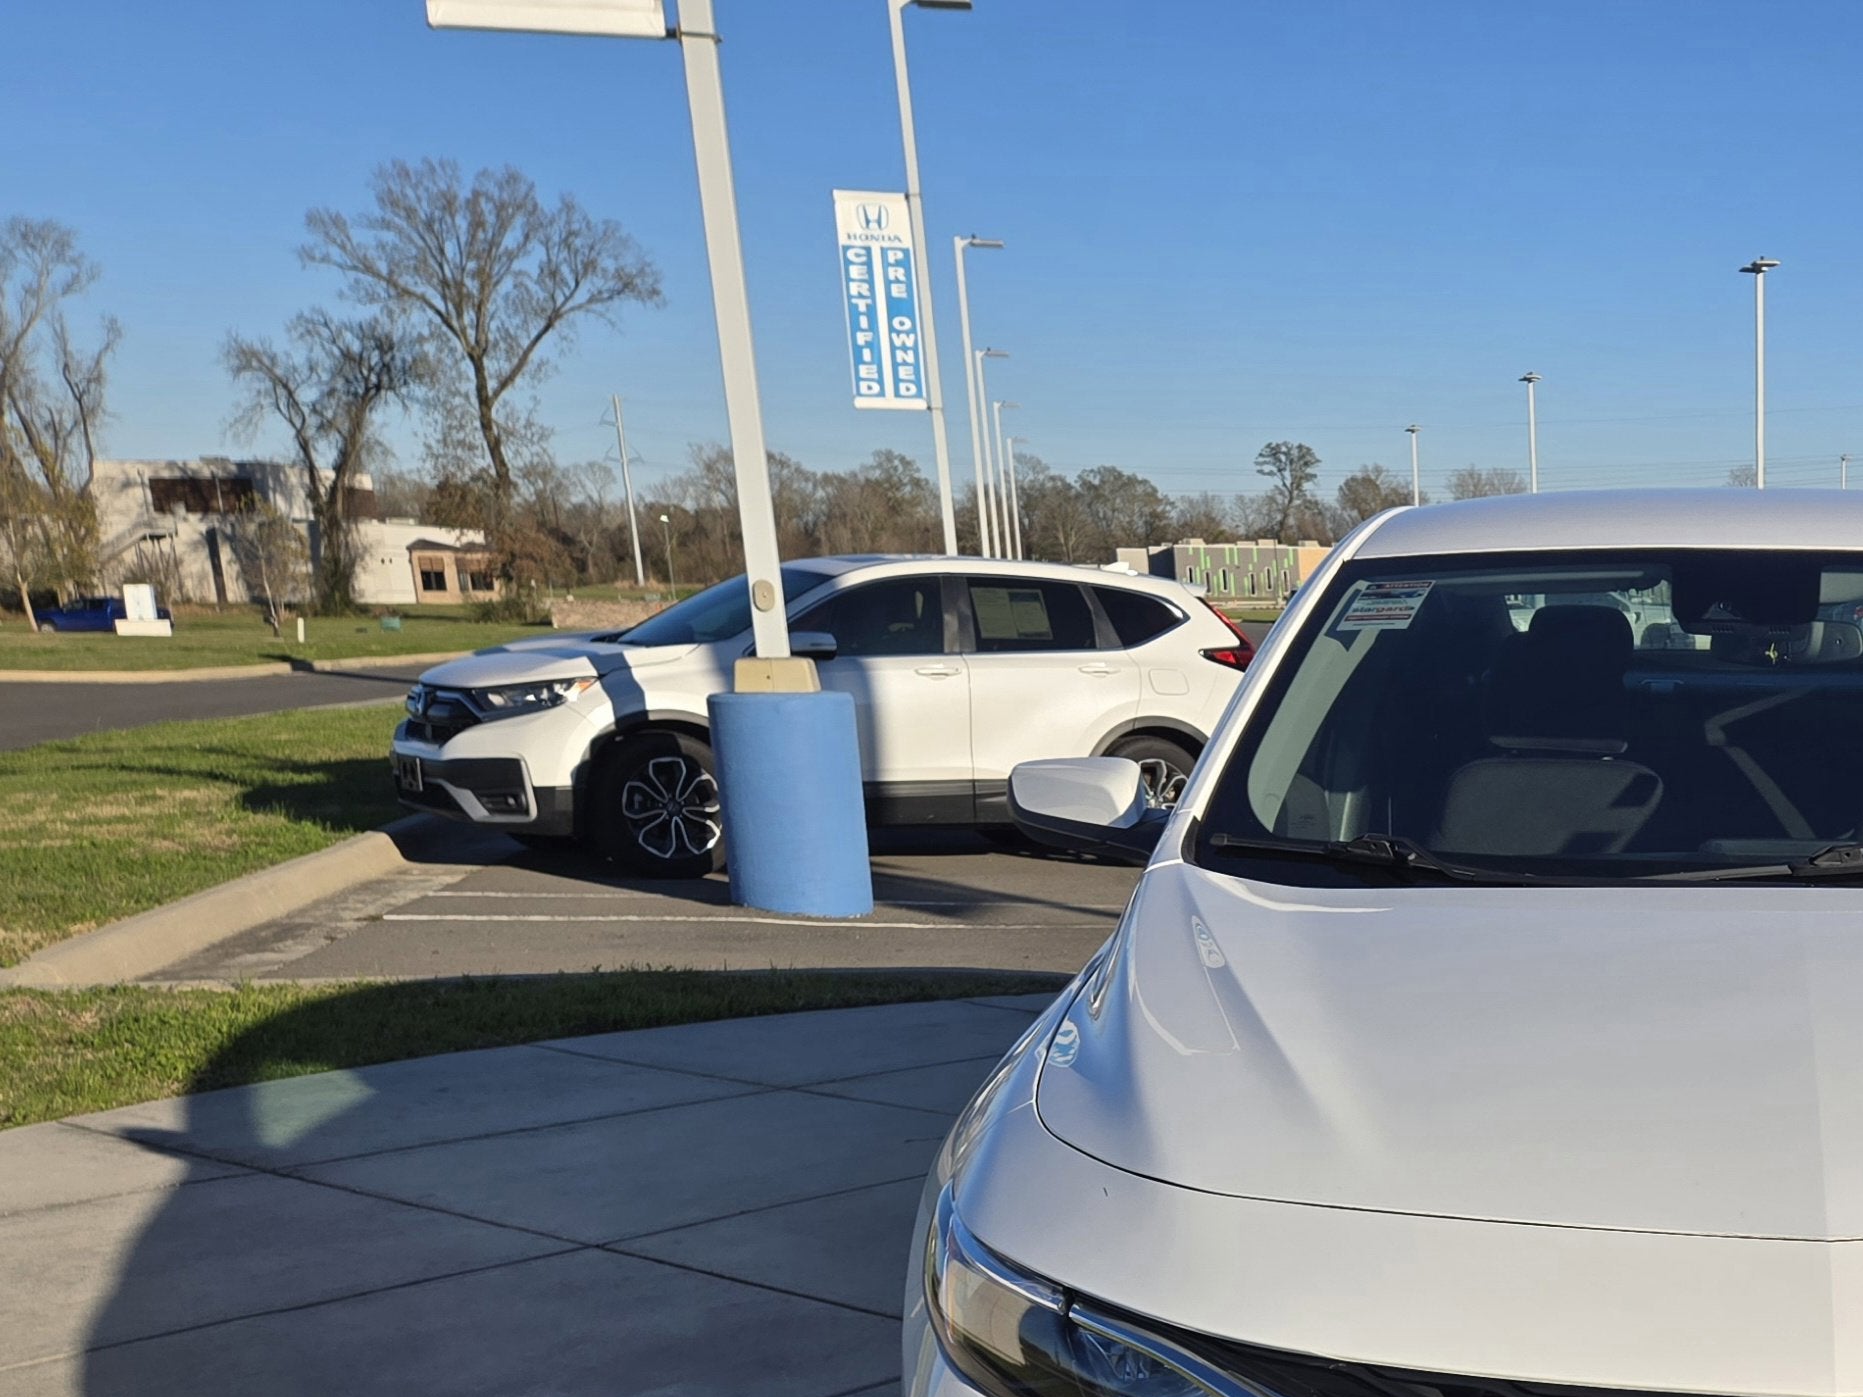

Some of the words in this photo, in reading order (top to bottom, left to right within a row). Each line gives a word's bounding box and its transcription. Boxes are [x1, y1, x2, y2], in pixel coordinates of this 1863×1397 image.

[846, 232, 903, 243] HONDA
[887, 249, 907, 298] PRE
[846, 248, 881, 396] CERTIFIED
[891, 316, 917, 397] OWNED
